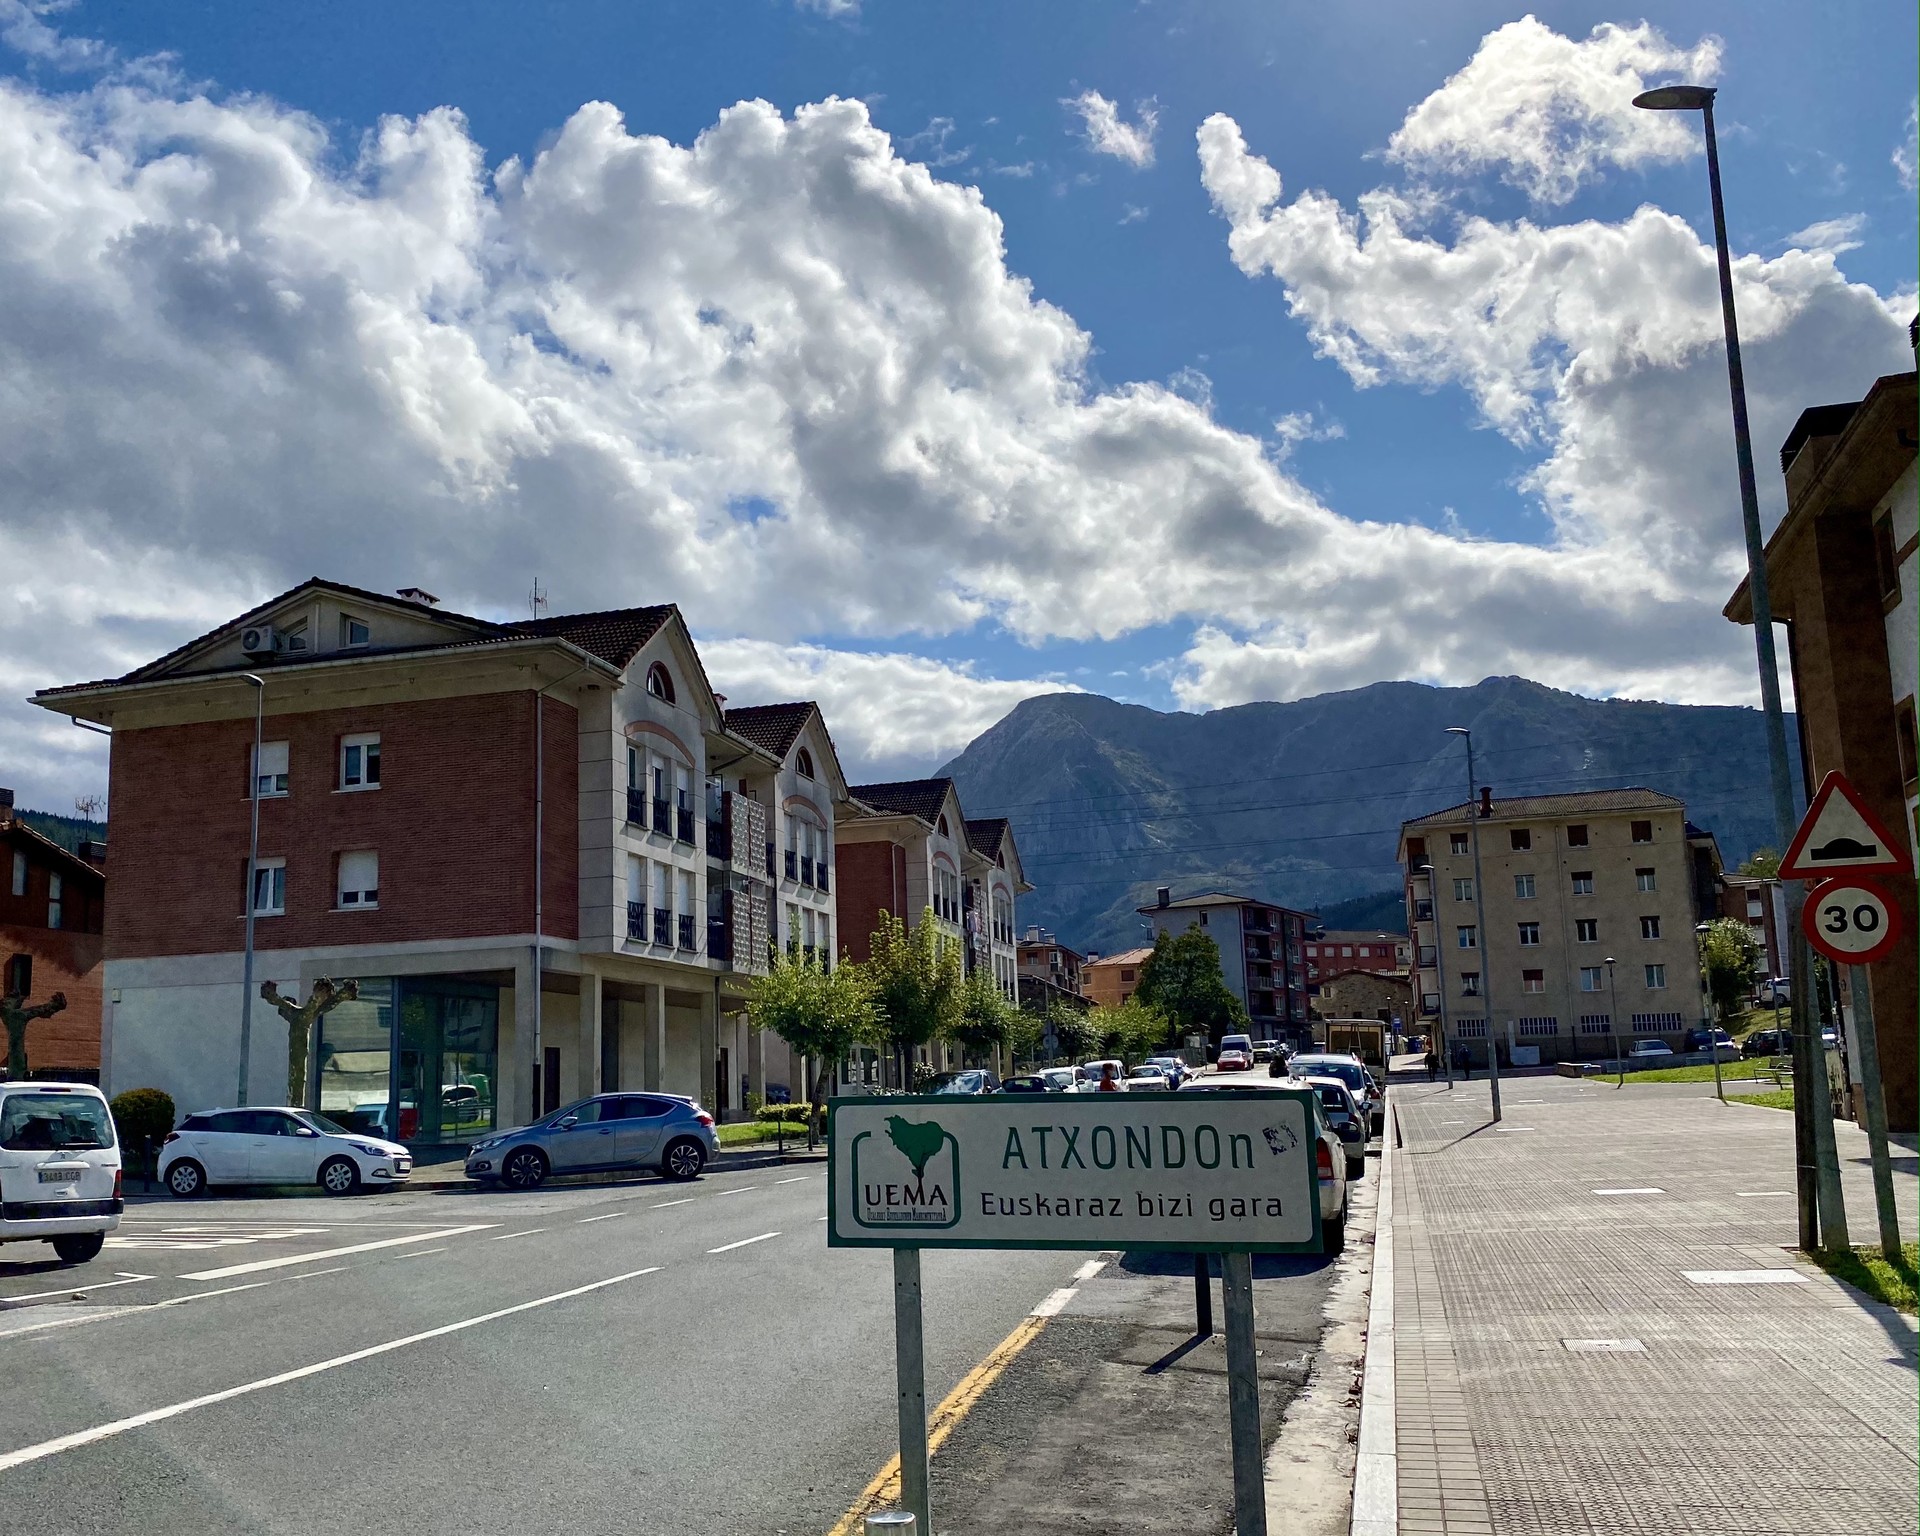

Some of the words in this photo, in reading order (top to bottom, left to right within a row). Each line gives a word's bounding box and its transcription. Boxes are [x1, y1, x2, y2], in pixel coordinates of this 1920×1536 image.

[1823, 904, 1880, 934] 30
[1002, 1124, 1255, 1170] ATXONDOn
[865, 1184, 949, 1206] UEMA
[981, 1192, 1124, 1217] Euskaraz
[1137, 1192, 1193, 1217] bizi
[1208, 1197, 1284, 1222] gara
